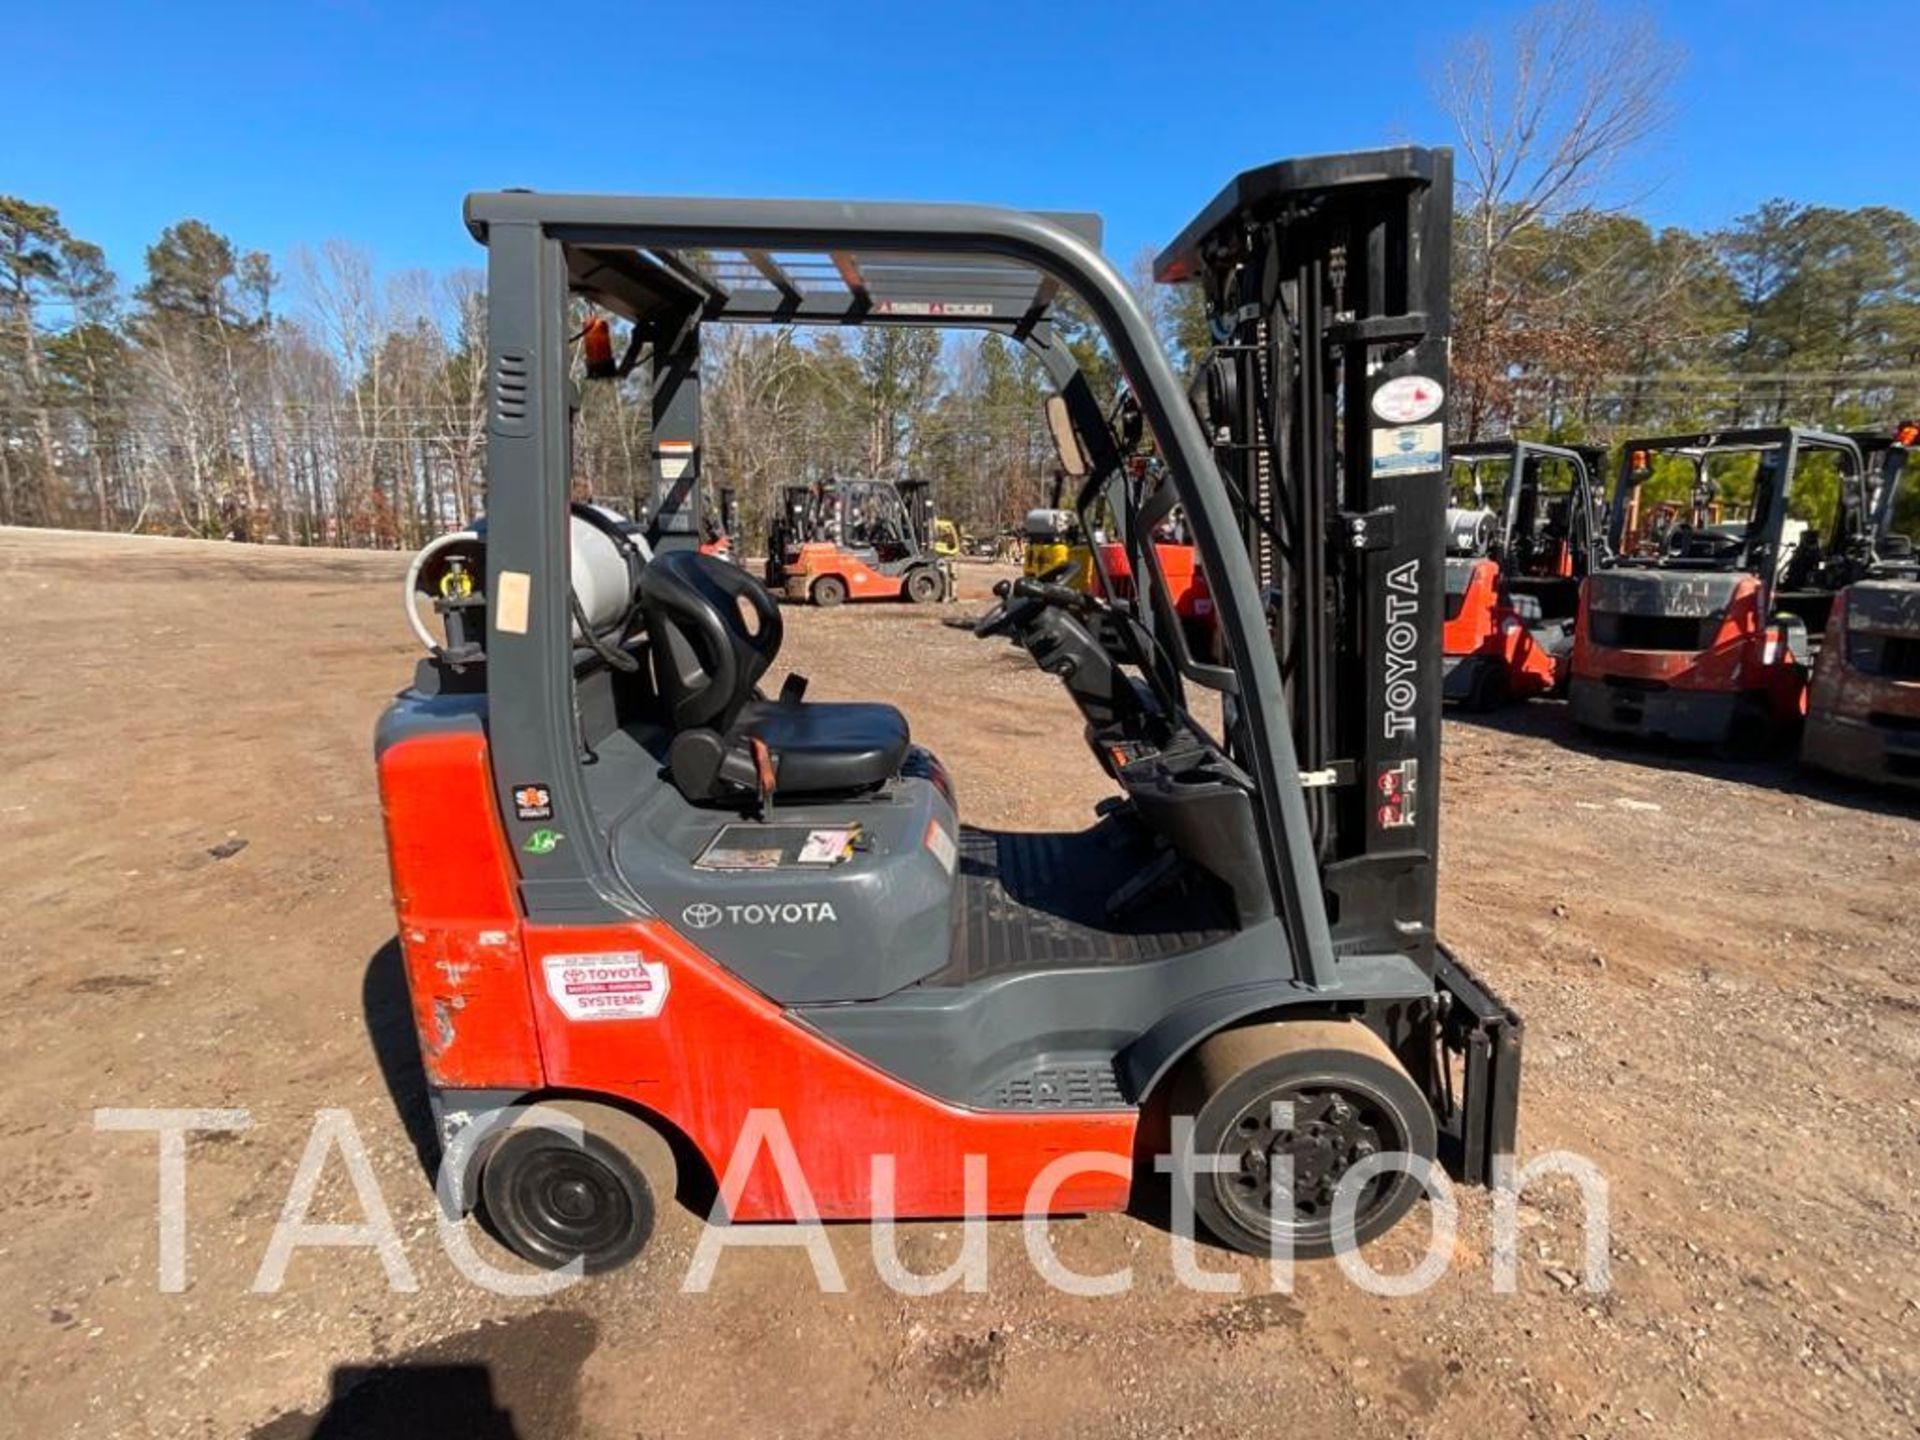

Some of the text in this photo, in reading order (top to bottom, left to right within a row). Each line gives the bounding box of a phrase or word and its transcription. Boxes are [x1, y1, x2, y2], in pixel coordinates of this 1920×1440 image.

[1384, 558, 1421, 739] TOYOTA
[725, 902, 837, 924] TOYOTA
[589, 968, 649, 980] TOYOTA
[578, 994, 644, 1008] SYSTEMS
